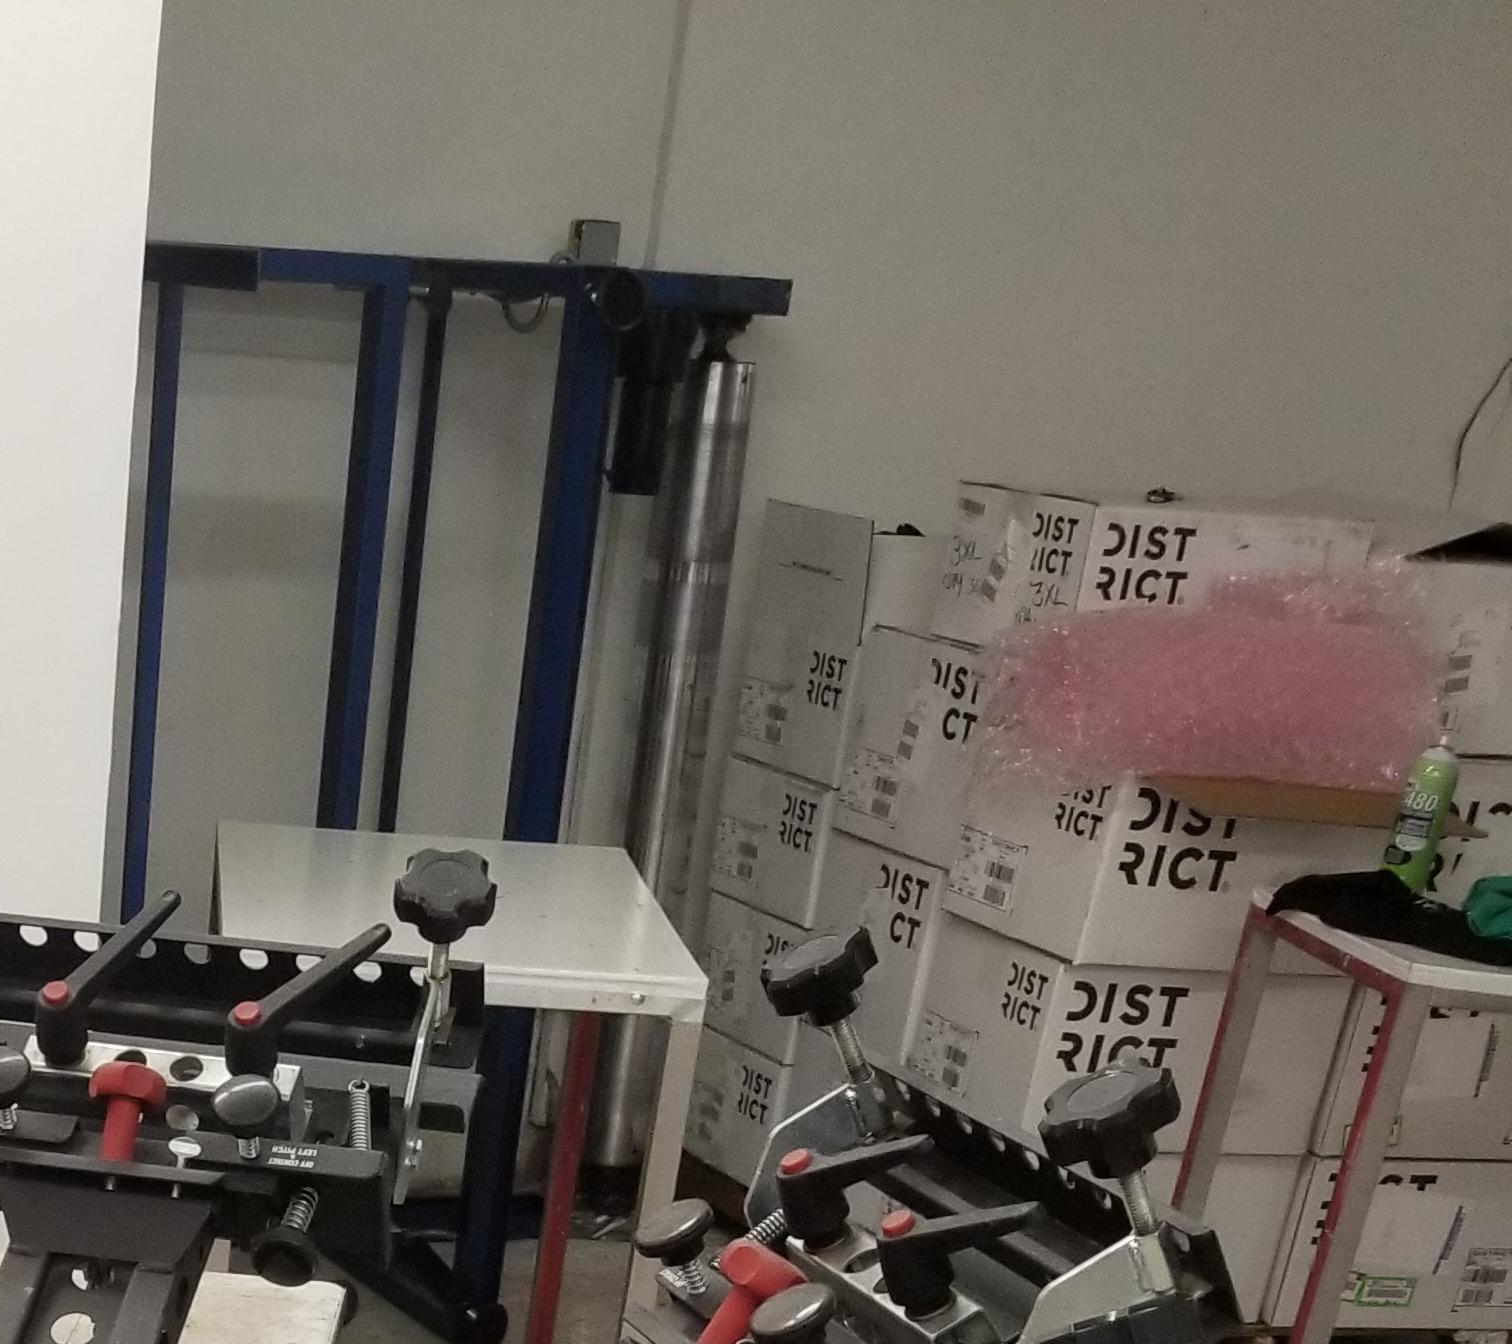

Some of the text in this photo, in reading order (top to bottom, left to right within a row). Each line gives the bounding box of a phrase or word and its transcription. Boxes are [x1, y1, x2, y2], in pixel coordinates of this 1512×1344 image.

[1032, 512, 1079, 544] DIST
[1102, 522, 1197, 561] DIST
[1095, 566, 1188, 605] RICT
[810, 650, 847, 682] DIST
[806, 679, 842, 711] RICT
[942, 707, 979, 744] CT
[782, 793, 818, 825] DIST
[1054, 802, 1104, 841] RICT
[779, 820, 813, 853] RICT
[1118, 842, 1238, 892] RICT
[875, 863, 930, 910] DIST
[889, 911, 922, 949] CT
[1006, 961, 1049, 1001] DIST
[1001, 991, 1041, 1031] RICT
[1065, 980, 1191, 1027] DIST
[742, 1065, 773, 1099] DIST
